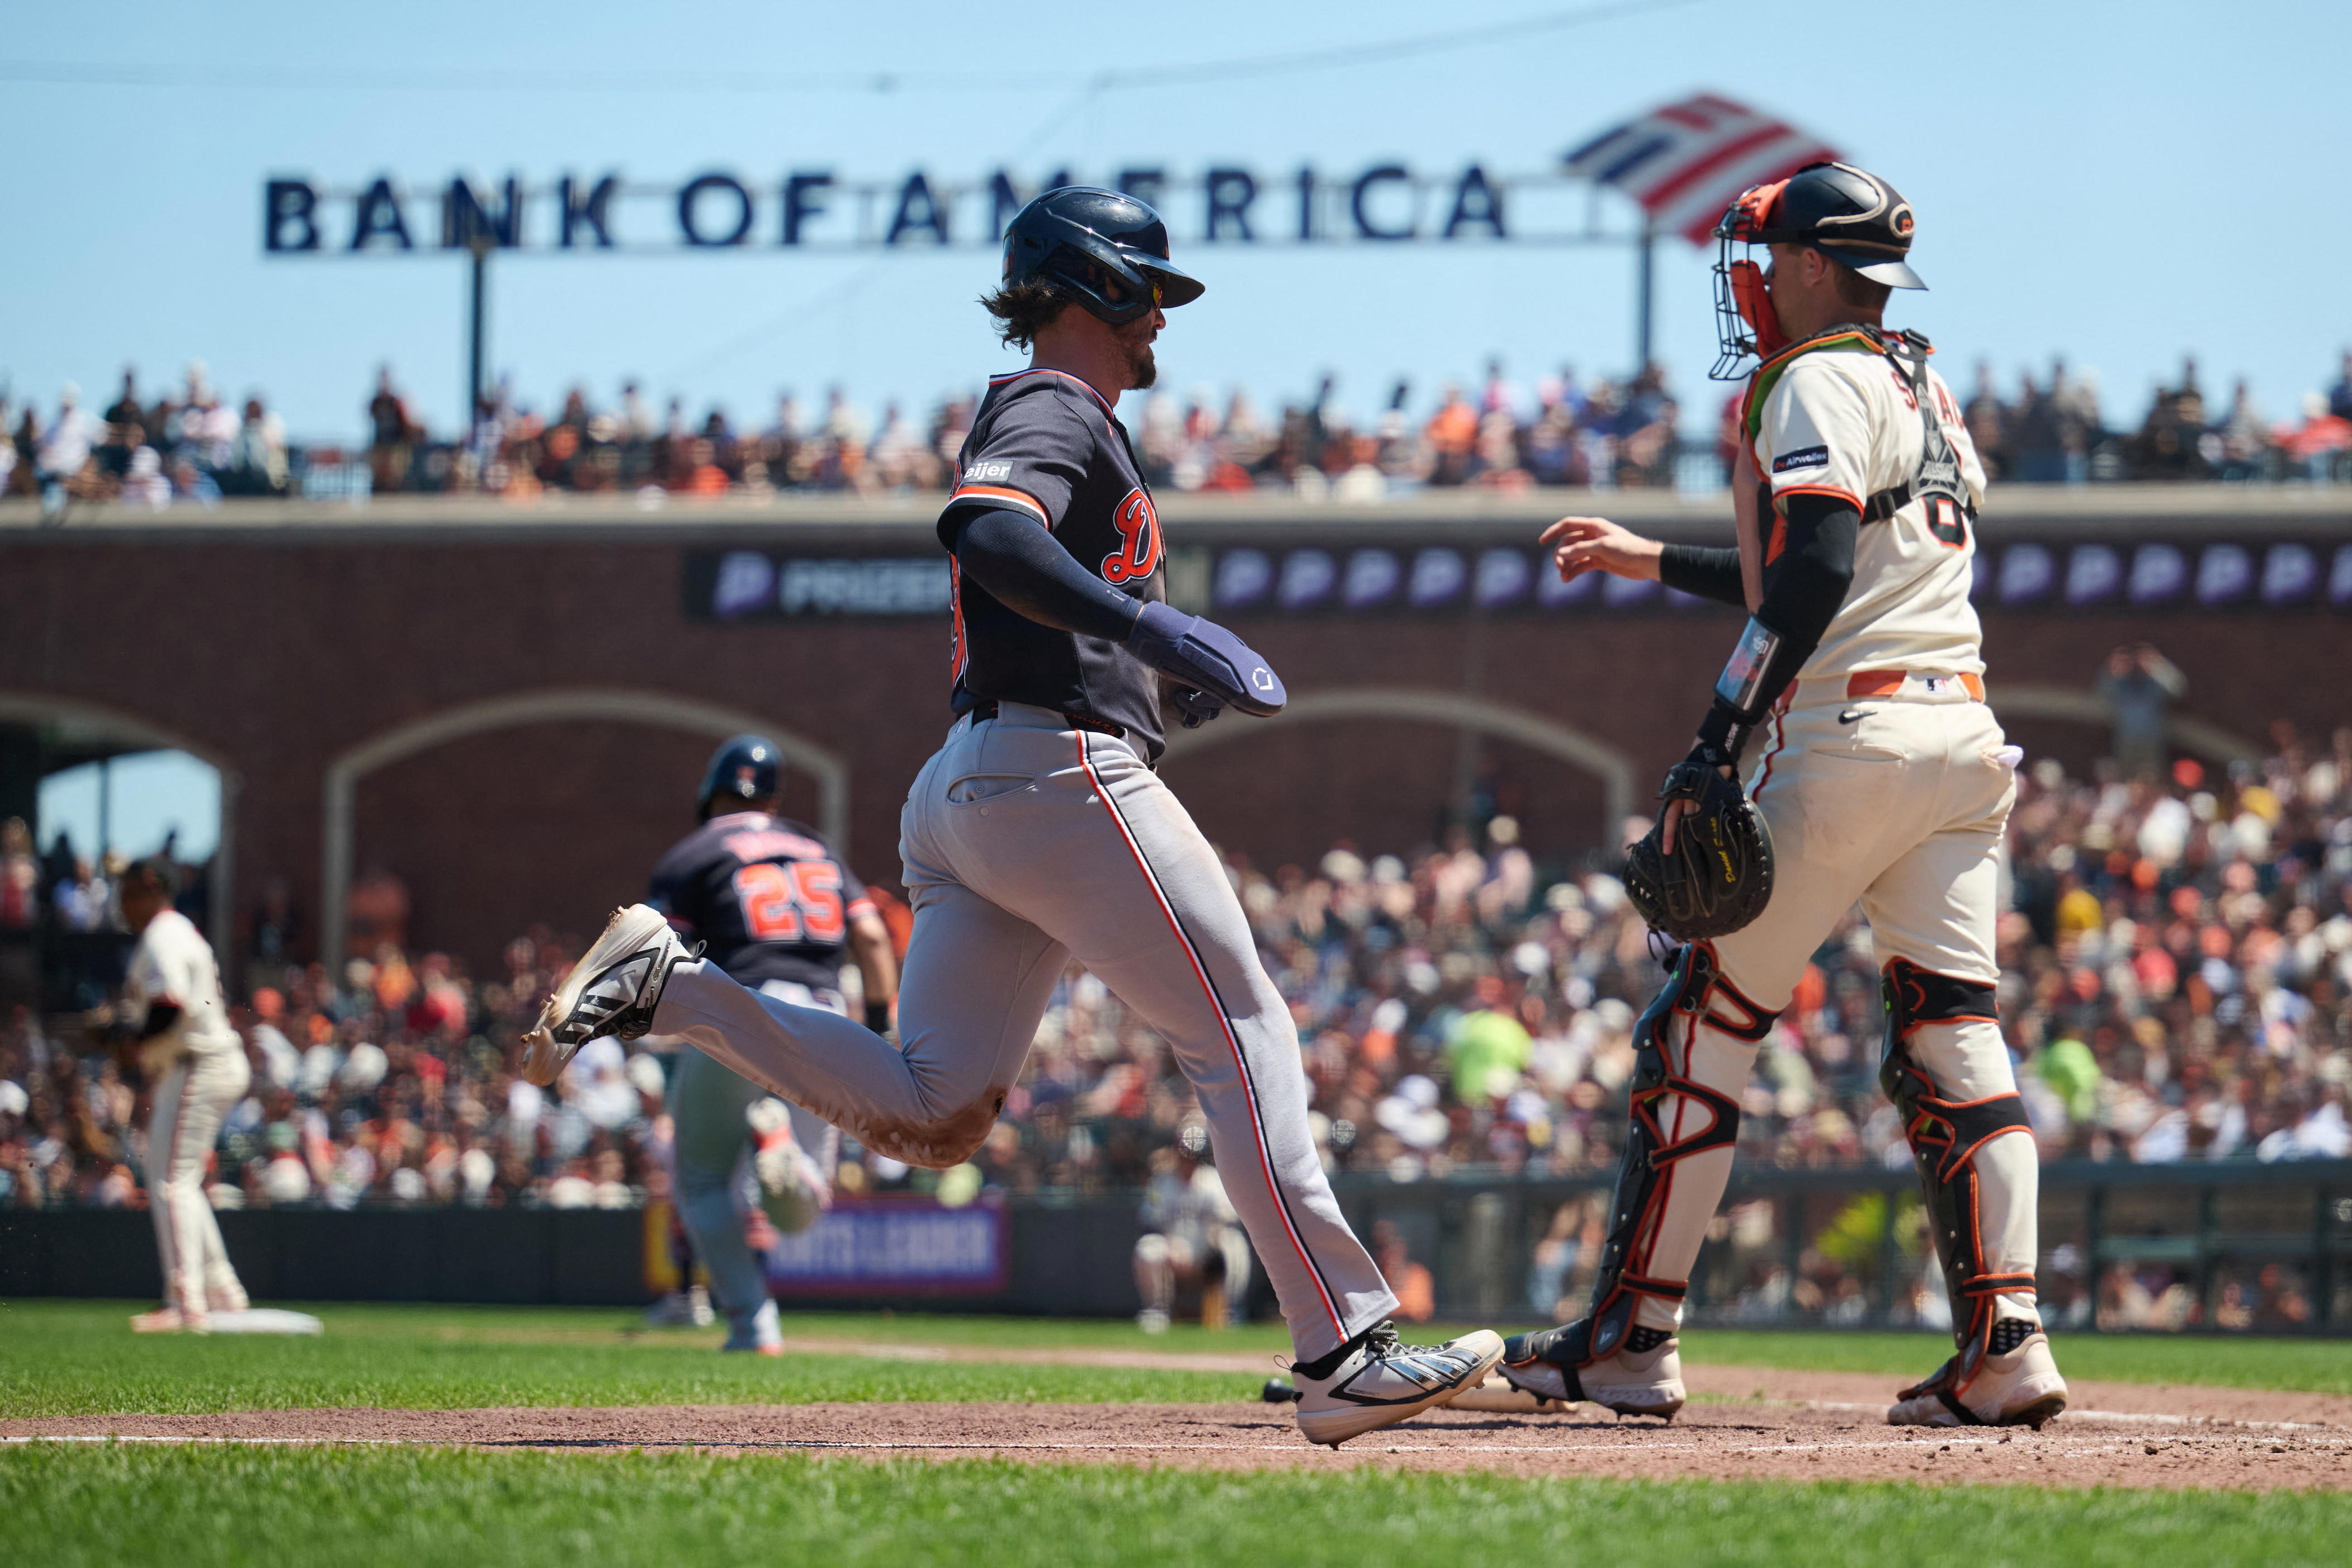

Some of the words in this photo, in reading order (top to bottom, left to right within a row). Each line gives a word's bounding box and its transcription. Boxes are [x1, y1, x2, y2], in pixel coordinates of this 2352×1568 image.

[264, 173, 618, 251] BANK
[678, 172, 835, 247] OF
[964, 462, 1010, 480] eijer
[1101, 488, 1165, 585] D
[781, 559, 952, 612] PRIZE
[732, 859, 846, 946] 25
